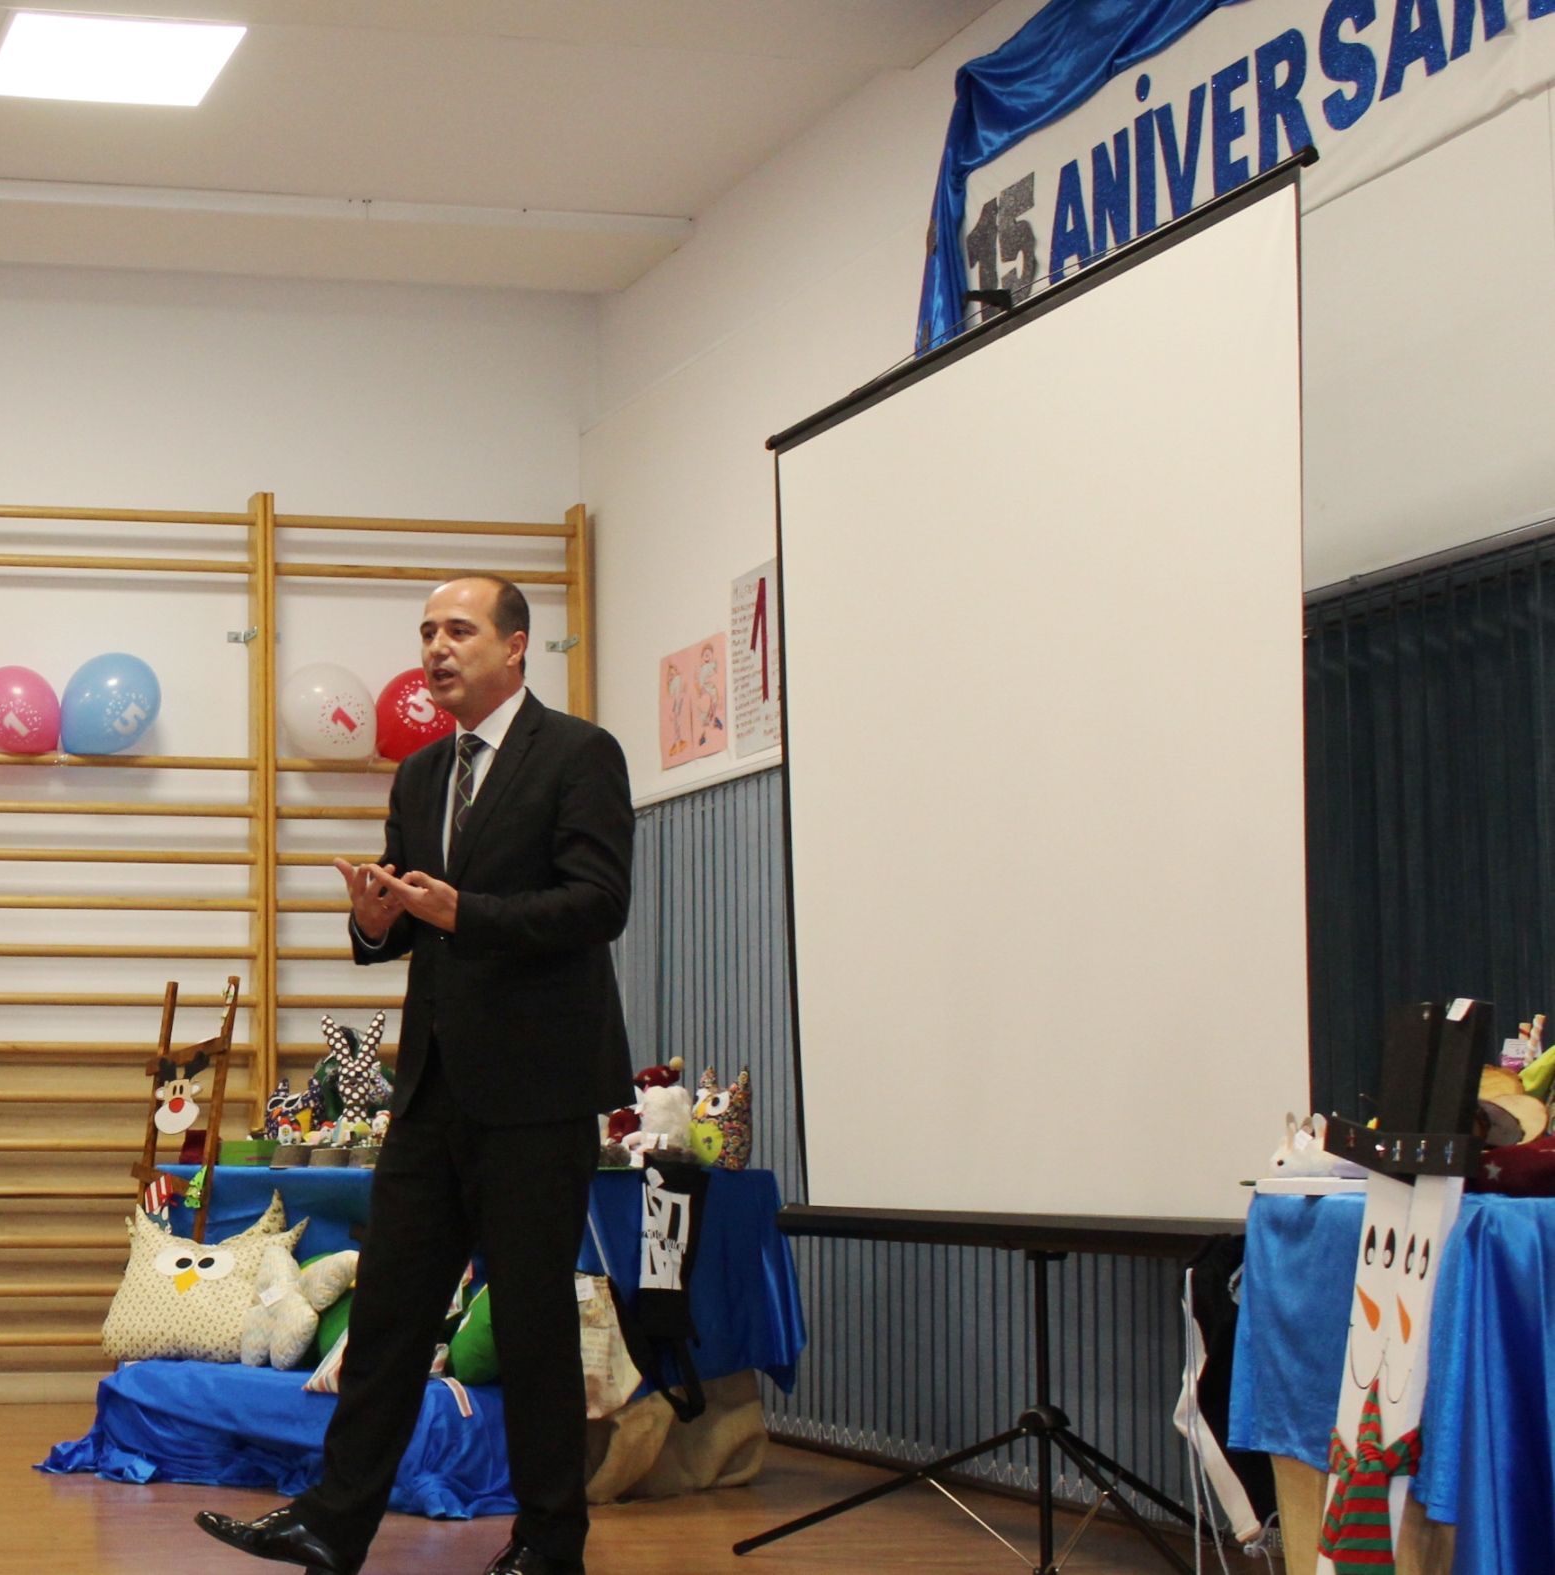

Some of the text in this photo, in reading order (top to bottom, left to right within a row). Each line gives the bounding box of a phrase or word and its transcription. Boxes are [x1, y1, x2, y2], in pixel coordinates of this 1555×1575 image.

[966, 171, 1037, 324] 15
[112, 702, 147, 736] 5
[332, 706, 357, 733] 1
[407, 687, 436, 724] 5
[2, 710, 30, 737] 1
